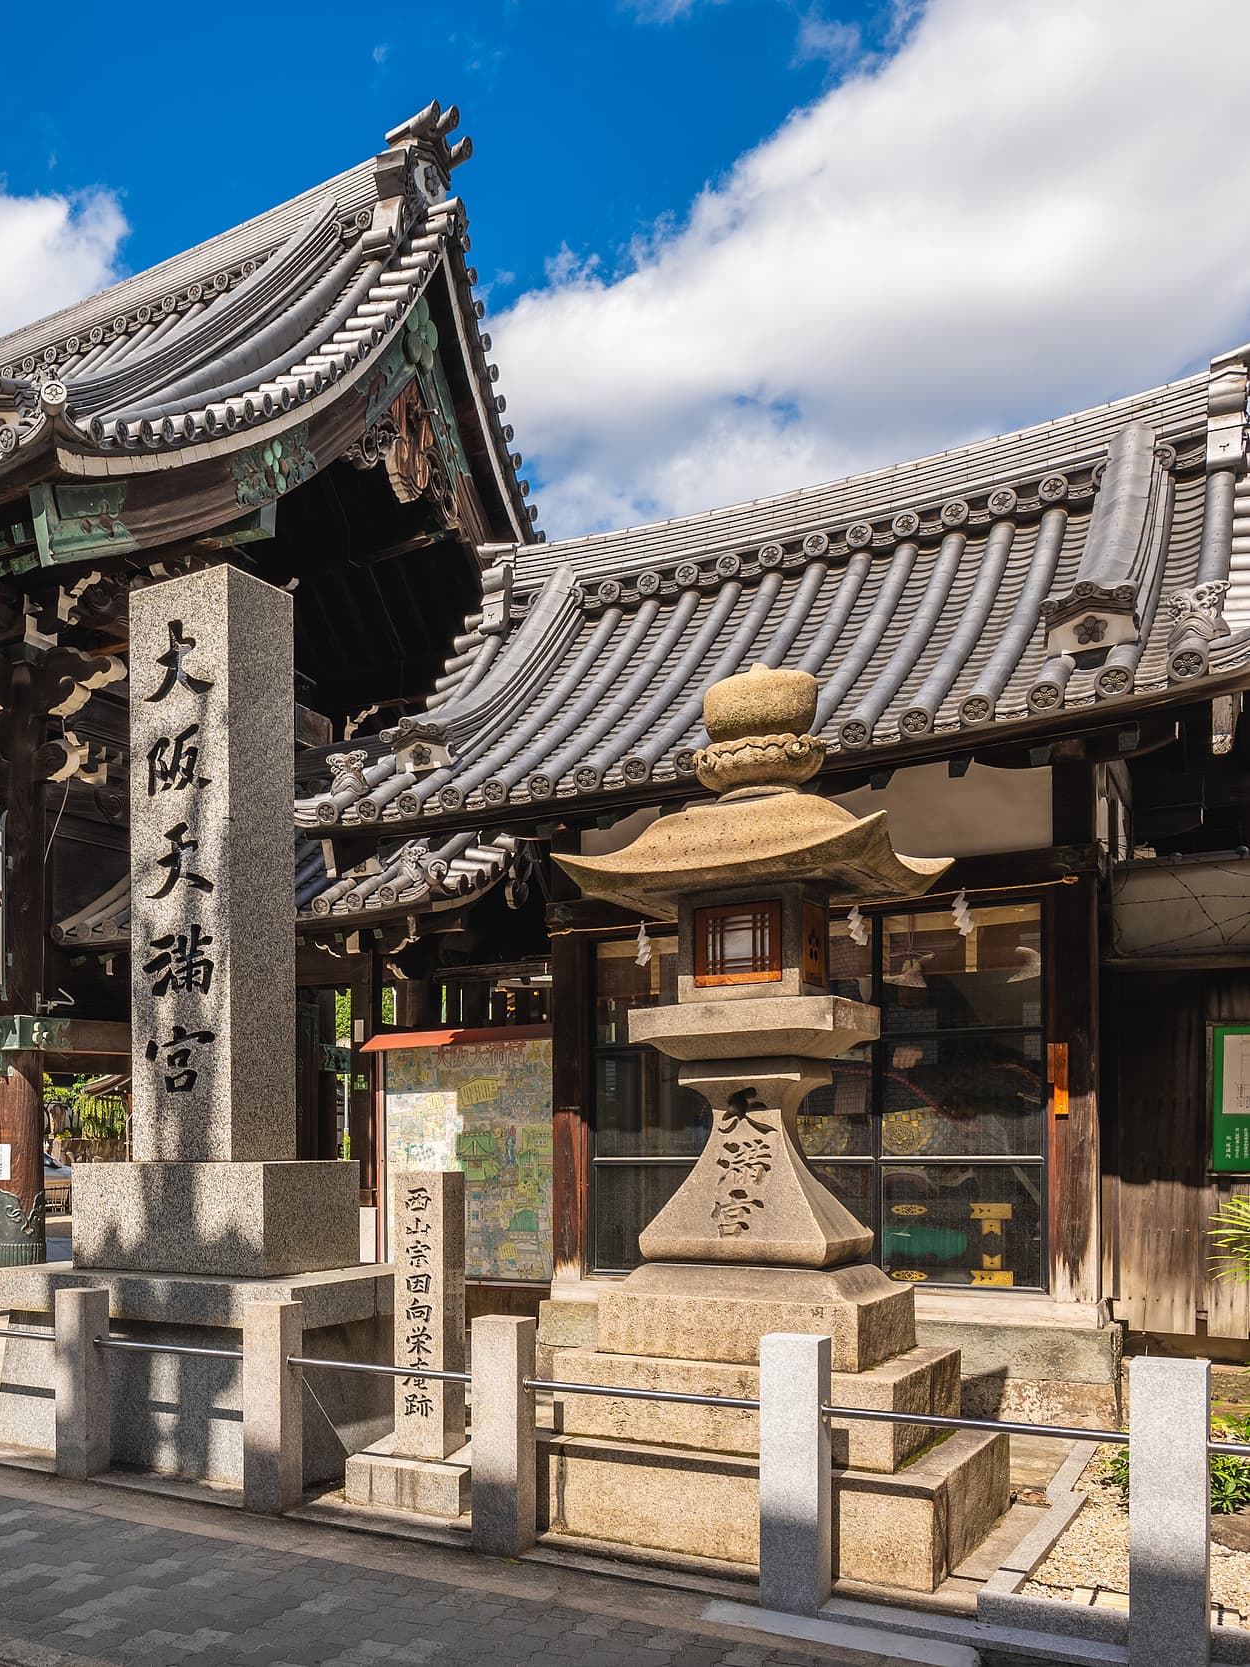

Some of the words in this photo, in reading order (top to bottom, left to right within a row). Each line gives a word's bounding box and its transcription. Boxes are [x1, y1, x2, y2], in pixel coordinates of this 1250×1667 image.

[143, 618, 216, 1094] 大阪天満宮
[710, 1086, 778, 1238] 天満宮
[401, 1186, 434, 1419] 西山宗因向栄庵跡
